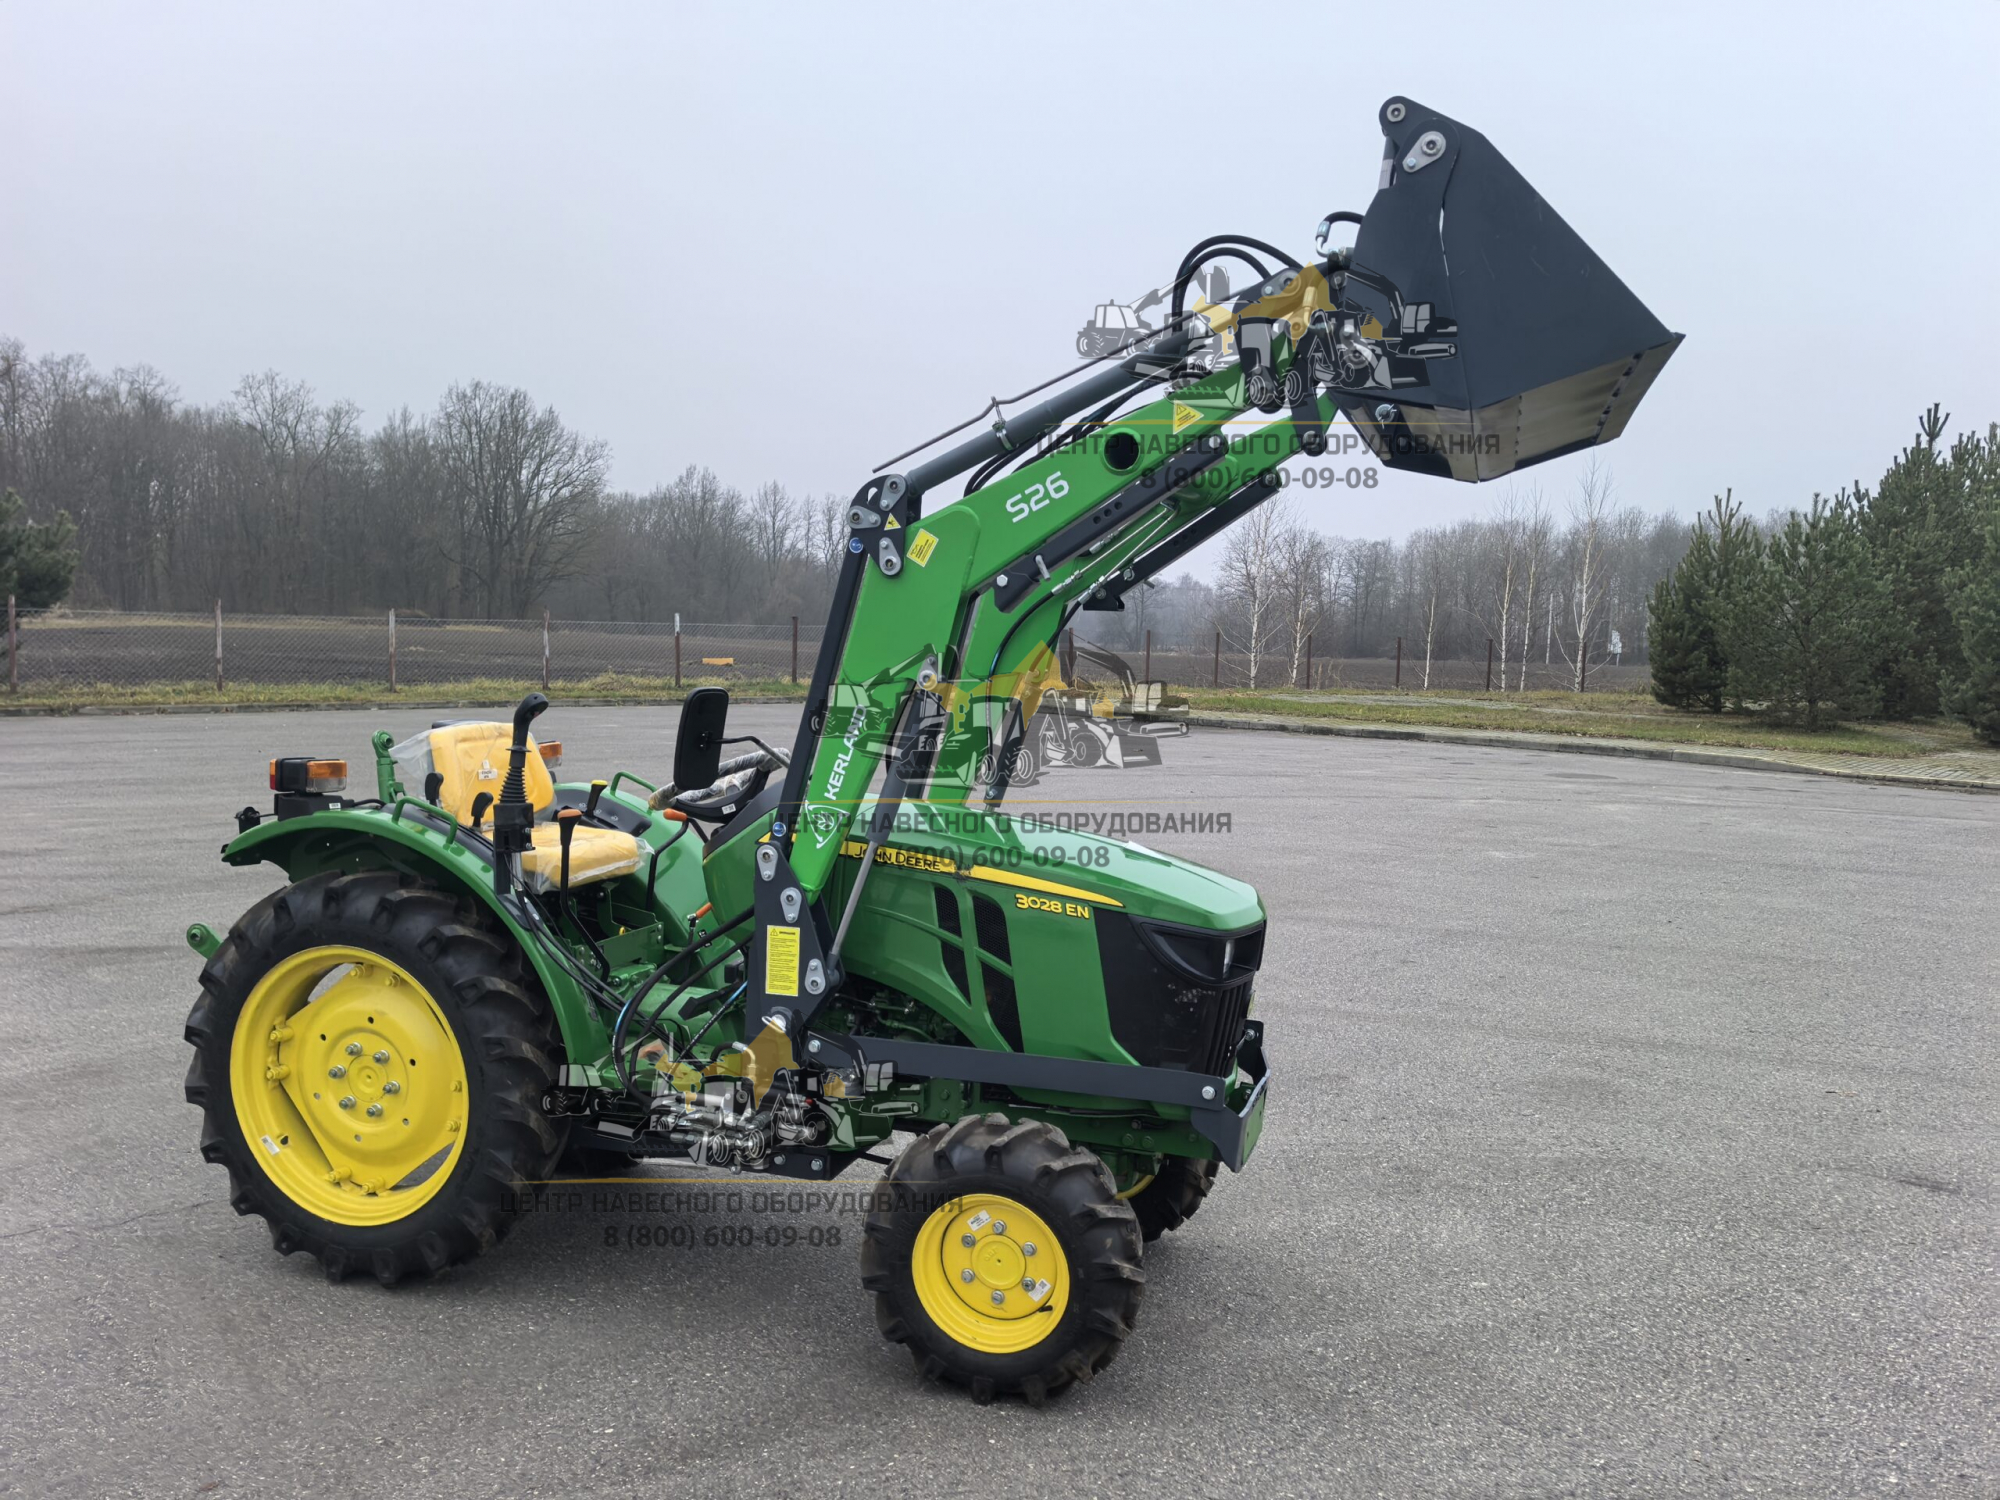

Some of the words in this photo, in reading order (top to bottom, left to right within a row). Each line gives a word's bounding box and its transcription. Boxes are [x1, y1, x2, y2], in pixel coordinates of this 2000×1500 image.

[1005, 470, 1069, 523] S26
[824, 704, 866, 800] KERLAND
[895, 851, 941, 870] DEERE
[1015, 893, 1062, 914] 3028
[1065, 905, 1090, 919] EN
